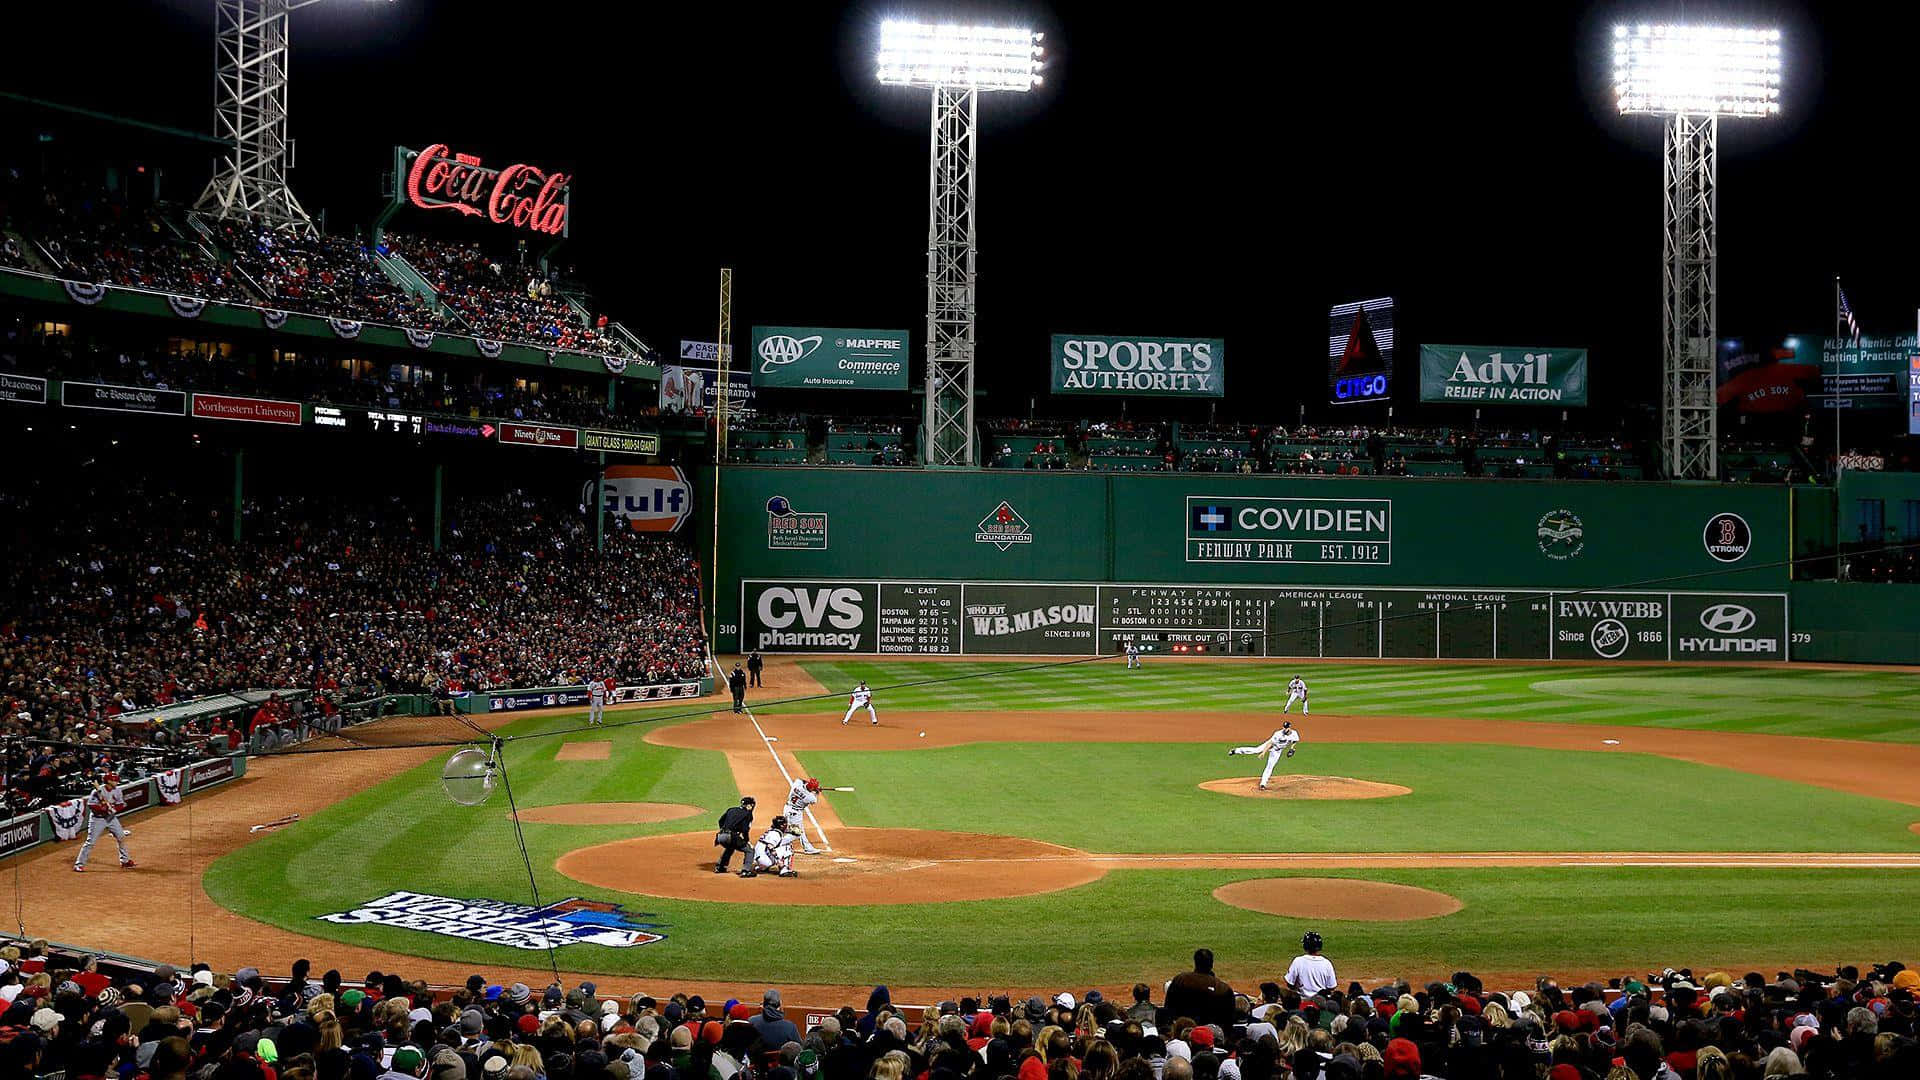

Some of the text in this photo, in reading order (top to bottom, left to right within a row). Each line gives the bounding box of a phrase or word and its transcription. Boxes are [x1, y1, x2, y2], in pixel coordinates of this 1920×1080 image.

[408, 143, 572, 235] Coca Cola
[764, 337, 797, 363] AAA
[846, 339, 901, 350] MAPFRE
[1063, 340, 1212, 372] SPORTS
[1860, 349, 1902, 361] Practice
[838, 359, 900, 371] Commerce
[1447, 352, 1549, 385] Advil
[1, 376, 42, 391] Deaconess
[803, 377, 855, 386] Auto Insurance
[1063, 370, 1211, 391] AUTHORITY
[1336, 375, 1386, 399] CITGO
[1444, 386, 1562, 401] RELIEF IN ACTION
[198, 400, 297, 422] Northeastern University
[546, 433, 561, 442] Nine
[603, 484, 685, 513] Gulf
[772, 517, 824, 530] RED SOX
[1238, 507, 1385, 532] COVIDIEN
[1718, 519, 1736, 545] B
[1198, 542, 1379, 560] FENWAY PARK EST. 1912
[1710, 545, 1745, 553] STRONG
[1132, 589, 1232, 598] FENWAY PARK
[1279, 591, 1325, 599] AMERICAN
[757, 586, 864, 630] CVS
[919, 599, 928, 607] W
[881, 608, 909, 616] BOSTON
[966, 606, 1006, 615] WHO BUT
[1559, 601, 1662, 619] F.W. WEBB
[881, 617, 902, 625] TAMPA
[903, 617, 916, 625] BAY
[1121, 617, 1147, 625] BOSTON
[719, 624, 737, 634] 310
[1044, 630, 1071, 638] SINCE
[759, 629, 862, 650] pharmacy
[1112, 633, 1211, 642] AT BAT BALL STRIKE OUT
[1559, 630, 1662, 643] Since 1866
[1791, 633, 1811, 643] 379
[1679, 638, 1777, 653] HYUNDAI
